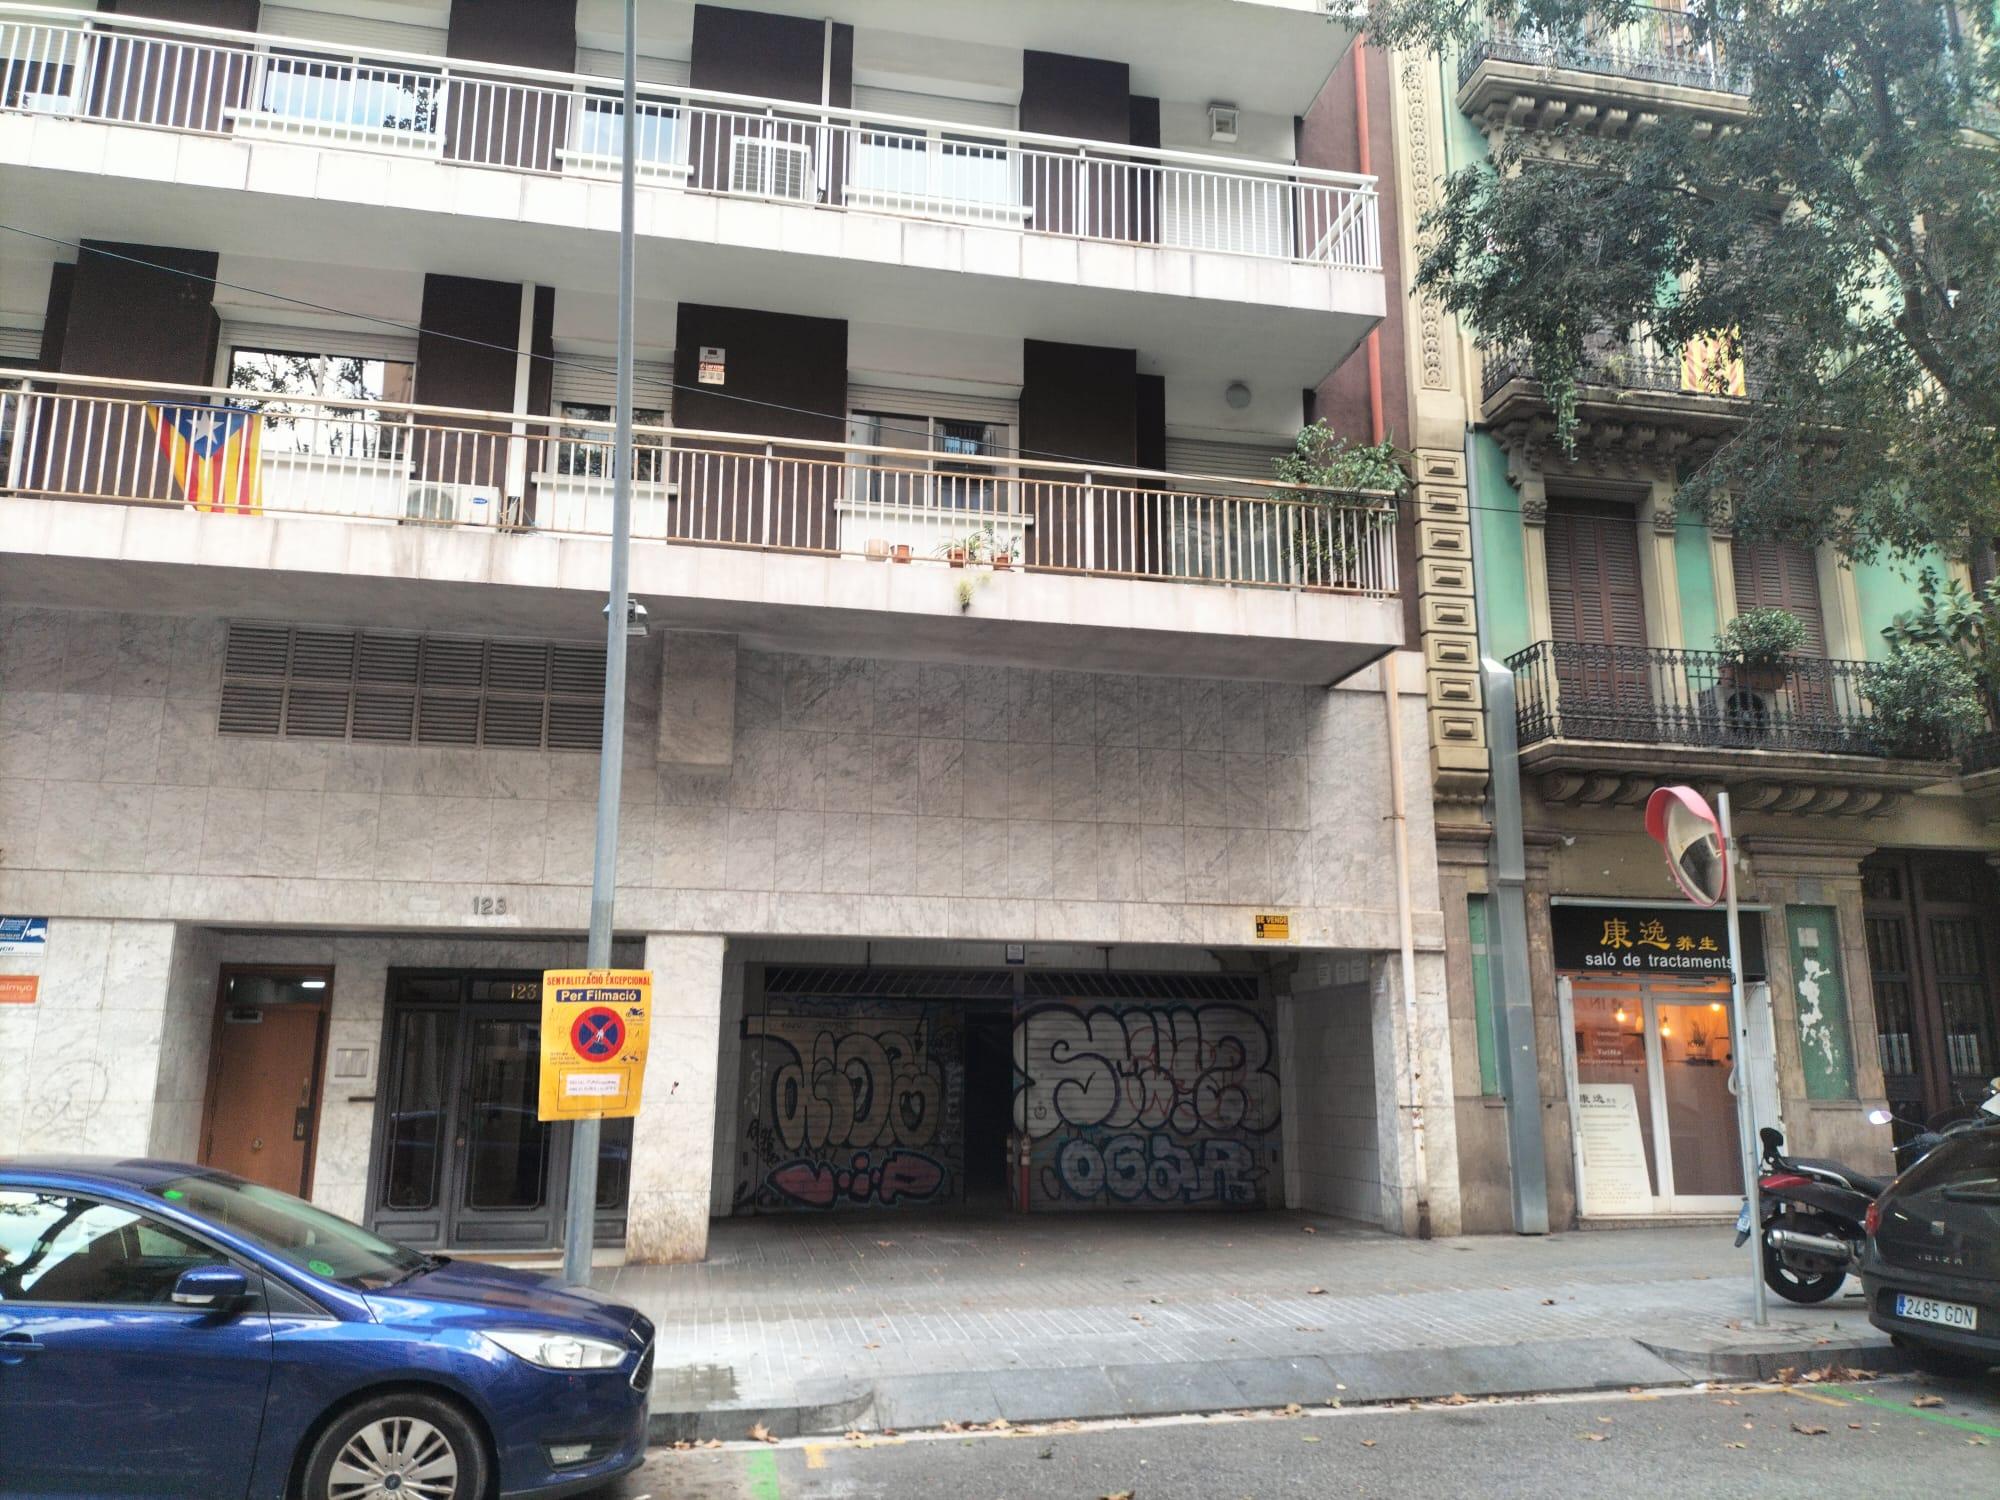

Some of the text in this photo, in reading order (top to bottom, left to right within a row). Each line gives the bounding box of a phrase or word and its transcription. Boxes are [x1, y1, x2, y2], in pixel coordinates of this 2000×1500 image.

[472, 896, 507, 915] 123
[1585, 952, 1616, 967] saló
[1622, 953, 1641, 967] de
[606, 975, 650, 986] EXCEPCIONAL
[511, 983, 538, 1000] 123
[561, 989, 637, 1001] Per Filmació
[1906, 1299, 1974, 1327] 2485 GDN
